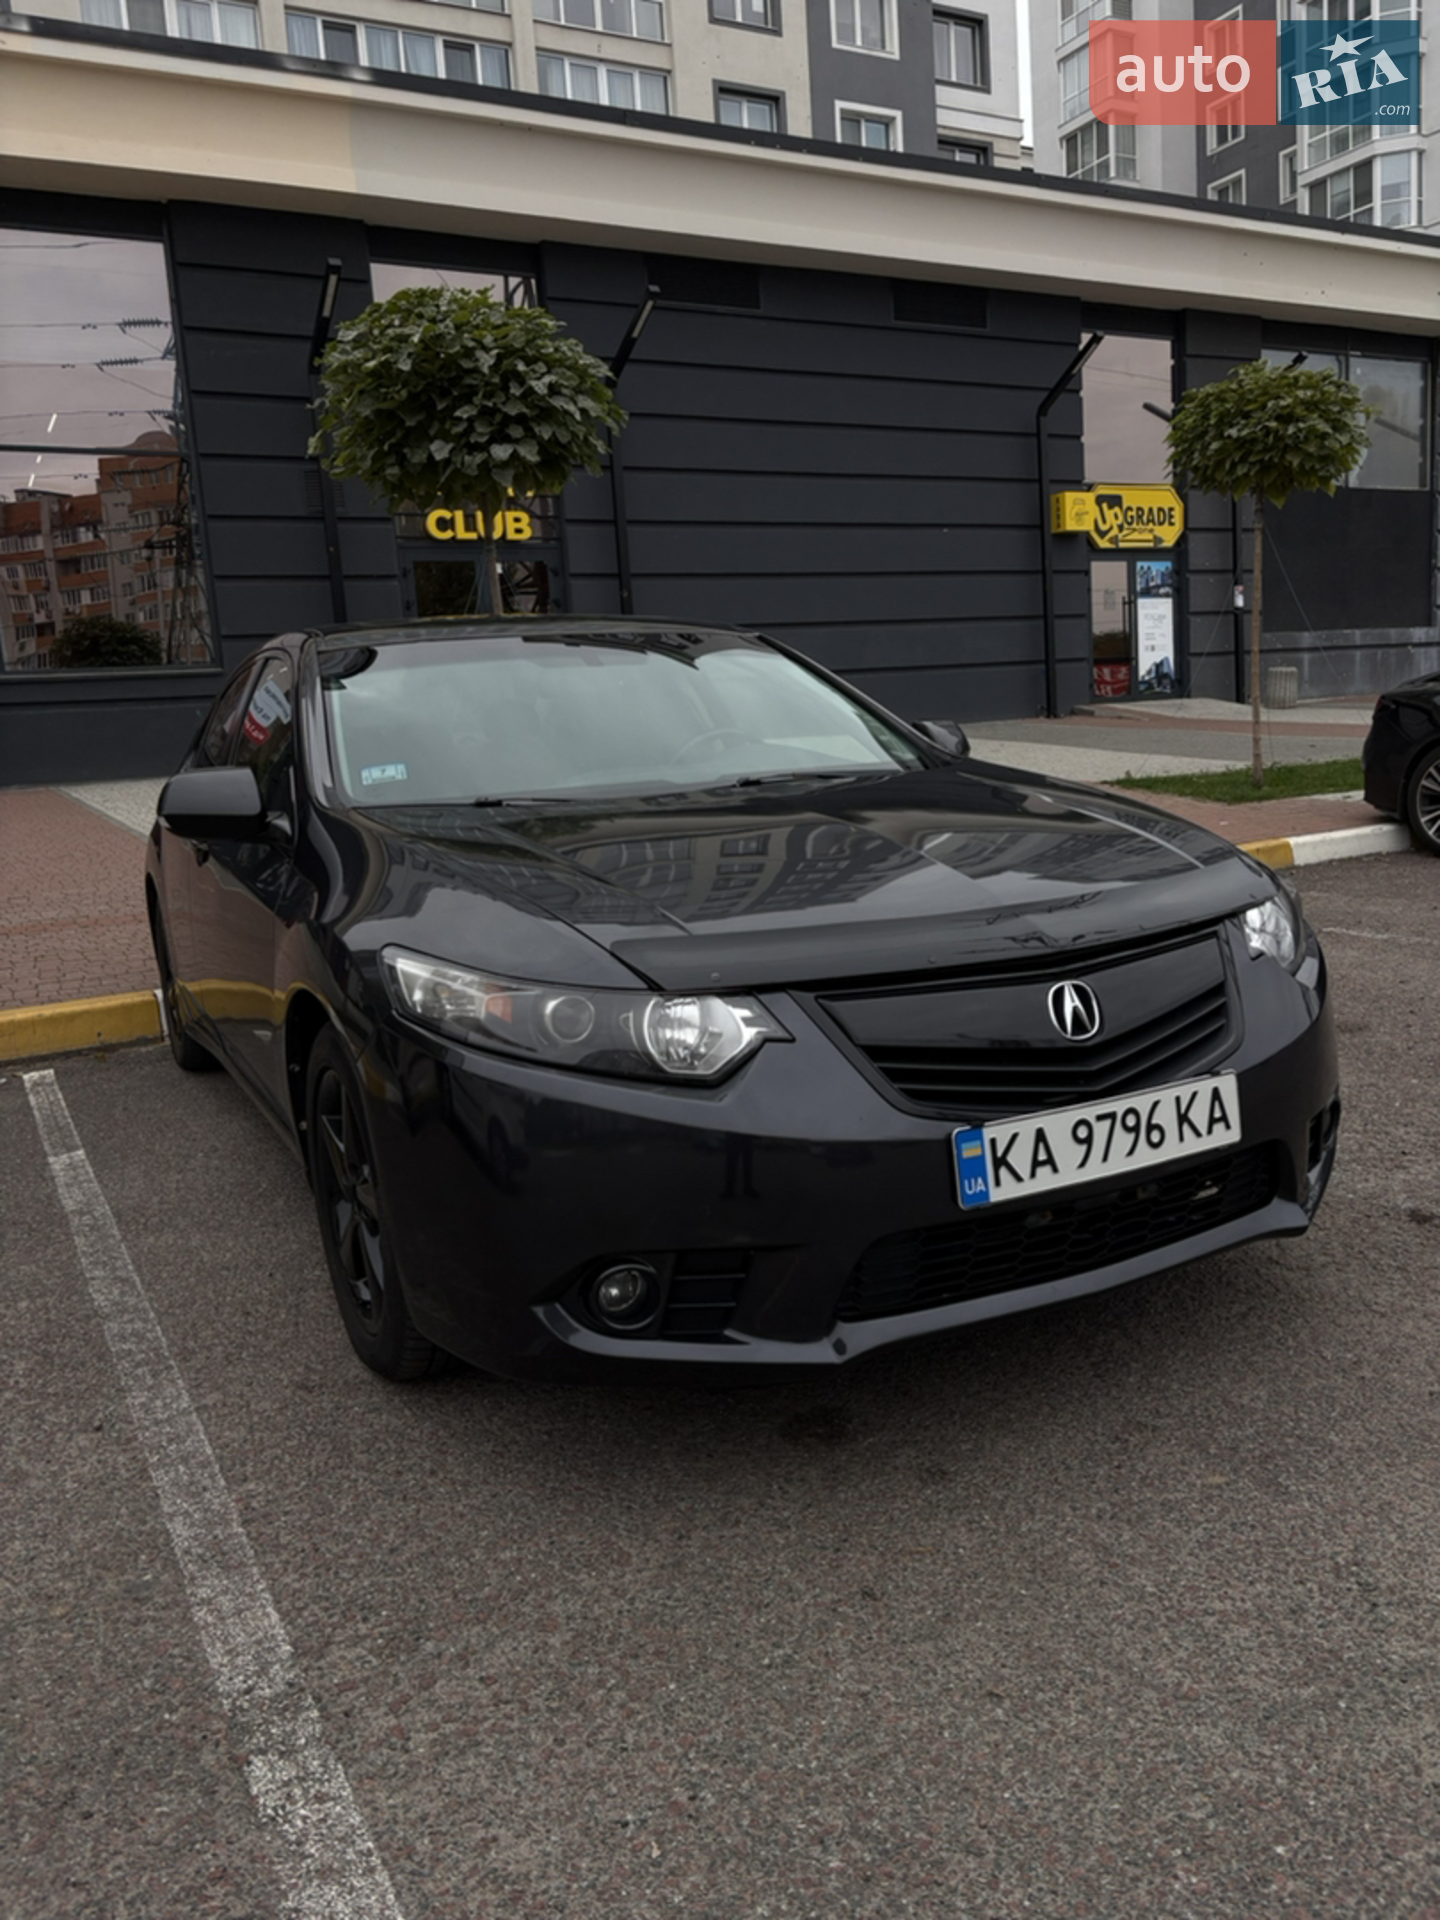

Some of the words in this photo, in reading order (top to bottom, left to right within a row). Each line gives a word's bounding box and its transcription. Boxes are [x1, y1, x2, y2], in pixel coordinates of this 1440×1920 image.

[426, 509, 532, 540] CLUB
[989, 1126, 1059, 1187] KA
[1071, 1099, 1166, 1169] 9796
[1174, 1086, 1231, 1143] KA
[964, 1176, 986, 1195] UA
